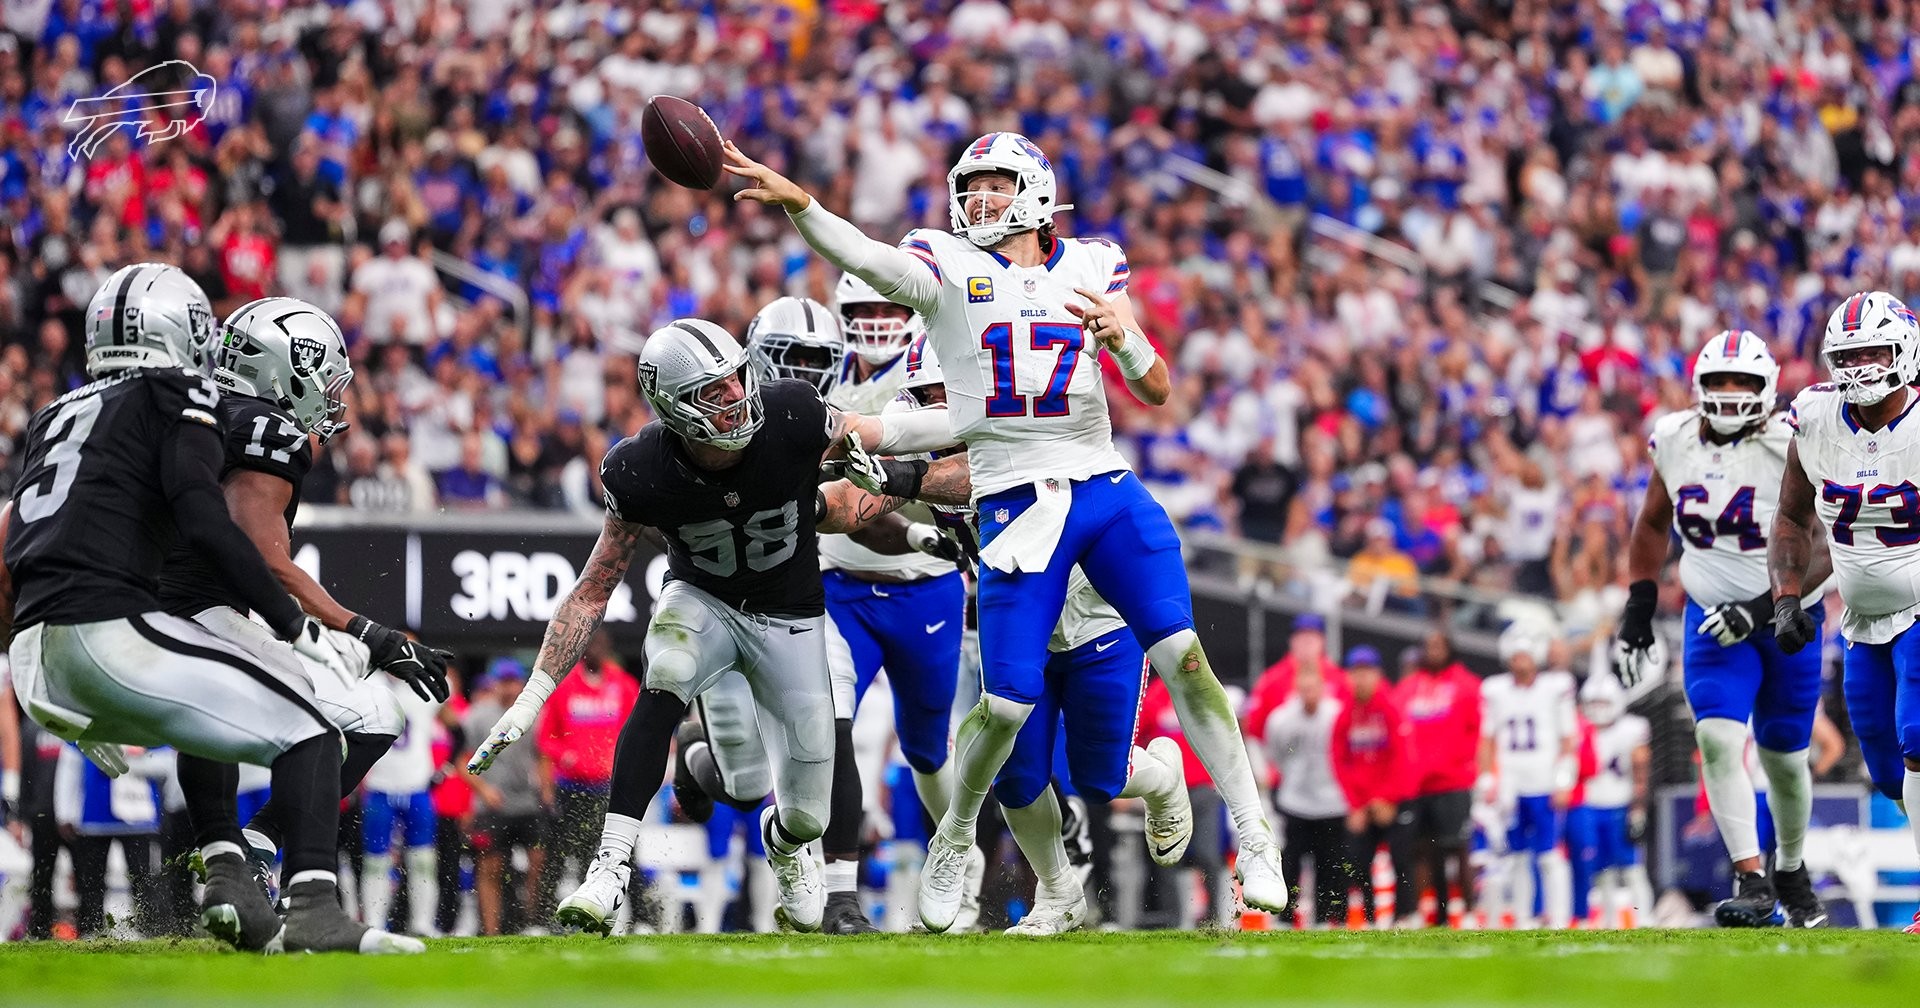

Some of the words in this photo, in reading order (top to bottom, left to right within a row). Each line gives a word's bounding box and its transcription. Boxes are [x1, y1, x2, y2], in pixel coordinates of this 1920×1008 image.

[969, 277, 993, 297] C
[1020, 309, 1047, 317] BILLS
[125, 325, 139, 343] 3
[293, 338, 325, 350] RAIDERS
[101, 350, 139, 359] RAIDERS
[981, 321, 1085, 418] 17
[182, 369, 220, 409] 3
[18, 391, 104, 524] 3
[244, 415, 309, 465] 17
[1855, 469, 1878, 479] BILLS
[1676, 484, 1767, 551] 64
[1822, 479, 1920, 548] 73
[449, 549, 578, 622] 3RD
